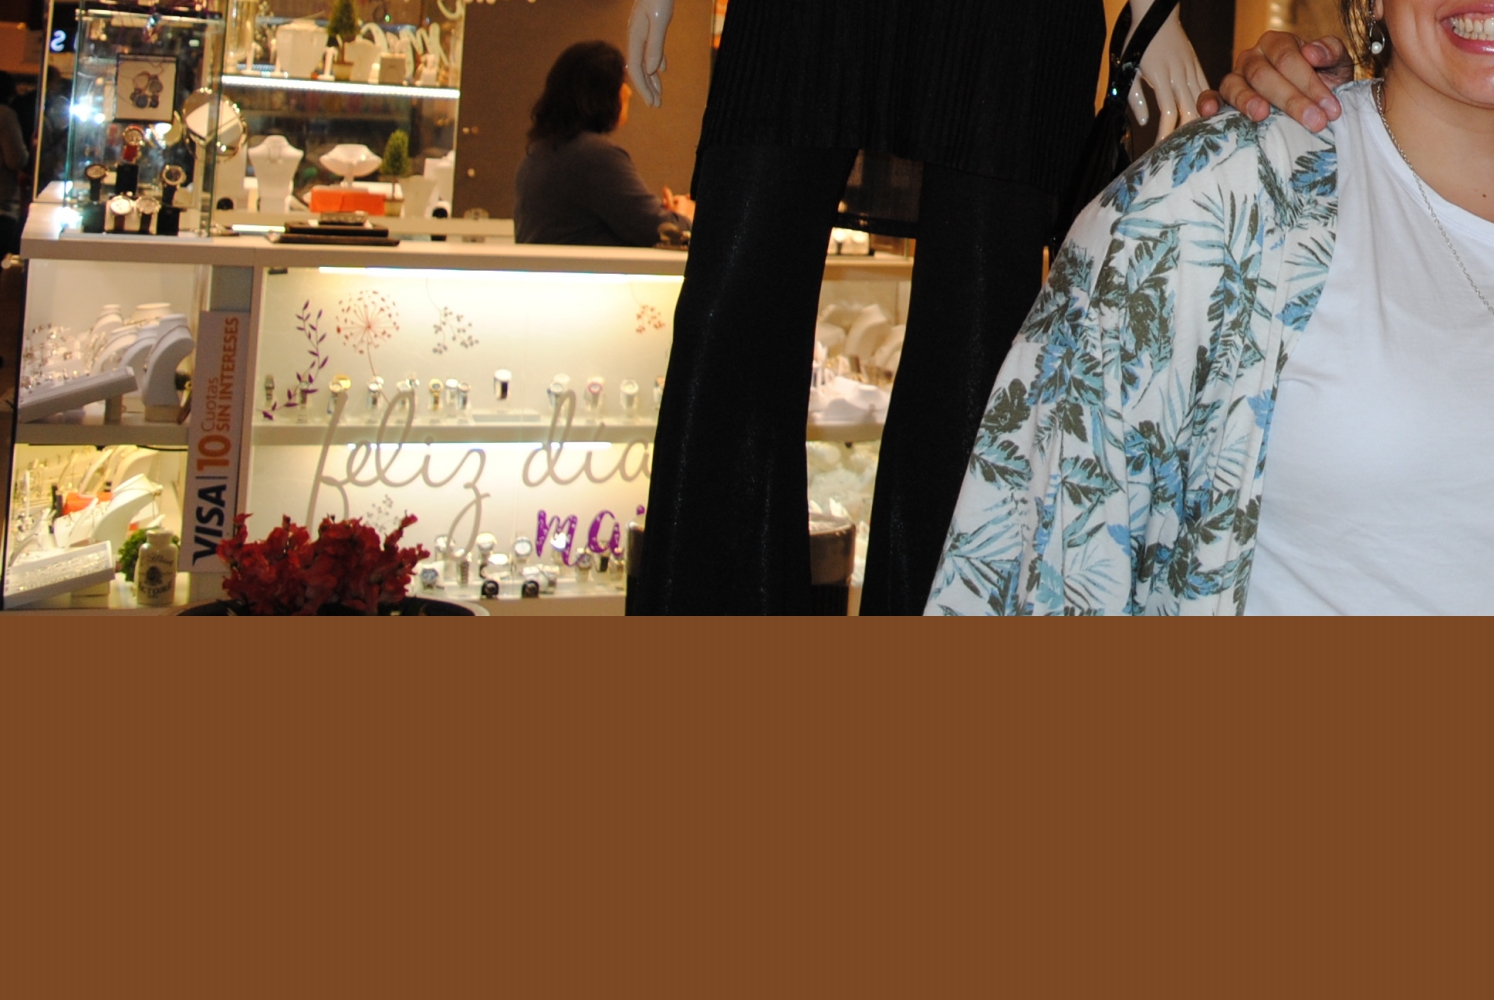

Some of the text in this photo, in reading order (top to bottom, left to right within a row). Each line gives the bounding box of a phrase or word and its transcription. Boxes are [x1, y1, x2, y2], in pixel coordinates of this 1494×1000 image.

[202, 377, 219, 432] Cuotas
[216, 316, 240, 432] SIN INTERESES
[192, 434, 232, 567] VISA 10
